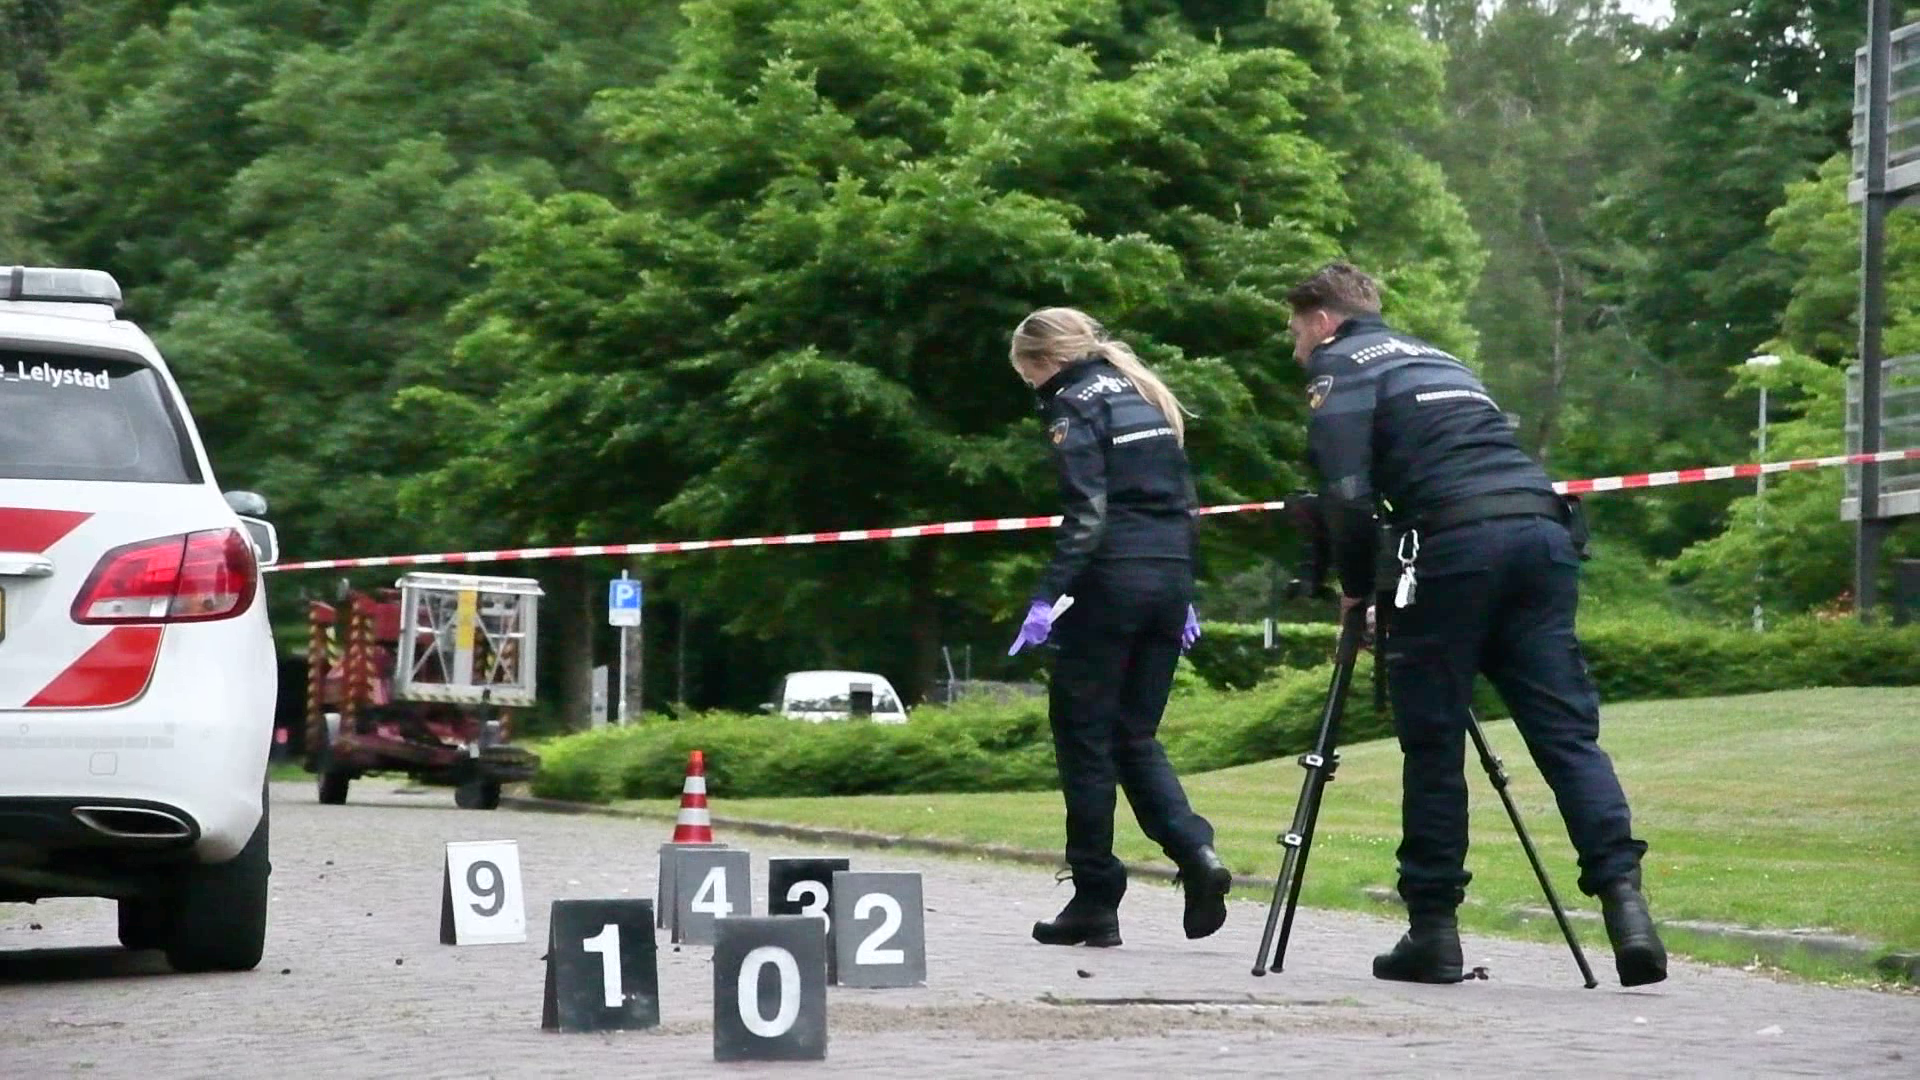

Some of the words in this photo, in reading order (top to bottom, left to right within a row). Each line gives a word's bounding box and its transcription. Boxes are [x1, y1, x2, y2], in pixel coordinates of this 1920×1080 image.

[616, 583, 634, 606] P
[466, 860, 505, 917] 9
[691, 866, 734, 918] 4
[786, 879, 831, 935] 3
[853, 892, 905, 966] 2
[582, 923, 623, 1008] 1
[737, 946, 802, 1038] 0
